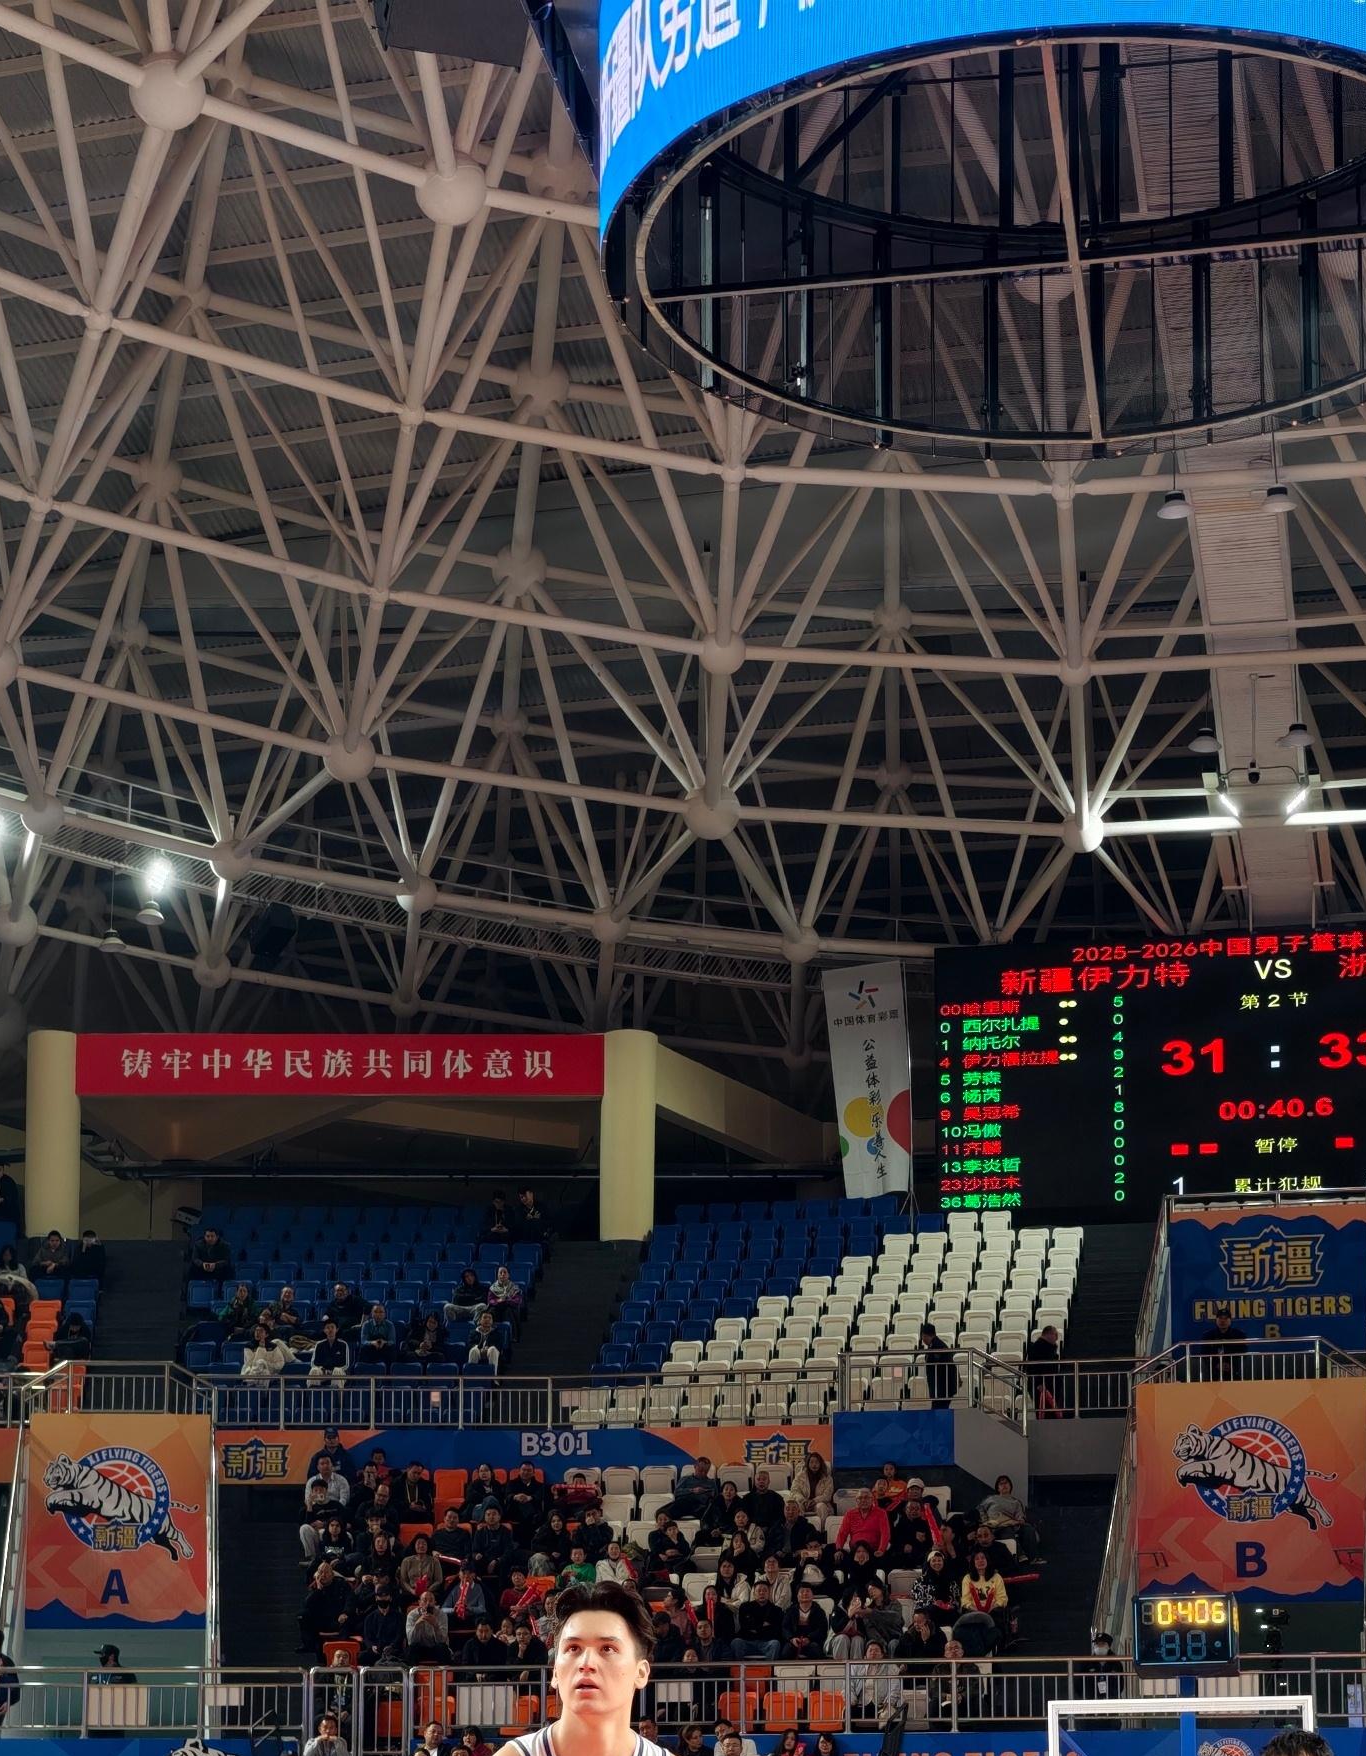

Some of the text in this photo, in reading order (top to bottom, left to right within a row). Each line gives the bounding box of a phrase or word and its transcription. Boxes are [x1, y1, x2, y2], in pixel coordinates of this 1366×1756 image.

[1001, 961, 1190, 995] 新疆伊力特
[1255, 960, 1292, 980] VS
[1114, 996, 1124, 1007] 5
[1268, 996, 1280, 1008] 2
[941, 1014, 1124, 1033] 0 西尔扎提 0
[941, 1031, 1124, 1051] 1 纳托尔 4
[121, 1047, 555, 1081] 铸牢中华民族共同体意识
[939, 1058, 951, 1068] 4
[1114, 1049, 1124, 1060] 9
[1161, 1038, 1227, 1077] 31
[941, 1075, 950, 1085] 5
[1114, 1067, 1124, 1078] 2
[941, 1092, 950, 1103] 6
[1115, 1084, 1122, 1095] 1
[940, 1110, 951, 1121] 9
[1114, 1102, 1124, 1113] 8
[1219, 1097, 1334, 1122] 00:40.6
[1114, 1119, 1124, 1130] 0
[1114, 1137, 1124, 1148] 0
[1254, 1137, 1298, 1155] 暂停
[1114, 1155, 1124, 1166] 0
[1114, 1173, 1124, 1184] 2
[1172, 1175, 1185, 1195] 1
[1234, 1175, 1322, 1192] 累计犯规
[1114, 1190, 1125, 1201] 0
[1231, 1240, 1314, 1288] 新疆
[1273, 1295, 1354, 1317] TIGERS
[521, 1433, 592, 1457] B301
[1233, 1418, 1272, 1432] FLYING
[1274, 1423, 1303, 1462] TIGERS
[101, 1447, 132, 1461] FLYING
[224, 1443, 288, 1479] 新疆
[1228, 1494, 1275, 1519] 新疆
[94, 1524, 138, 1550] 新疆
[1235, 1541, 1268, 1578] B
[100, 1569, 130, 1605] A
